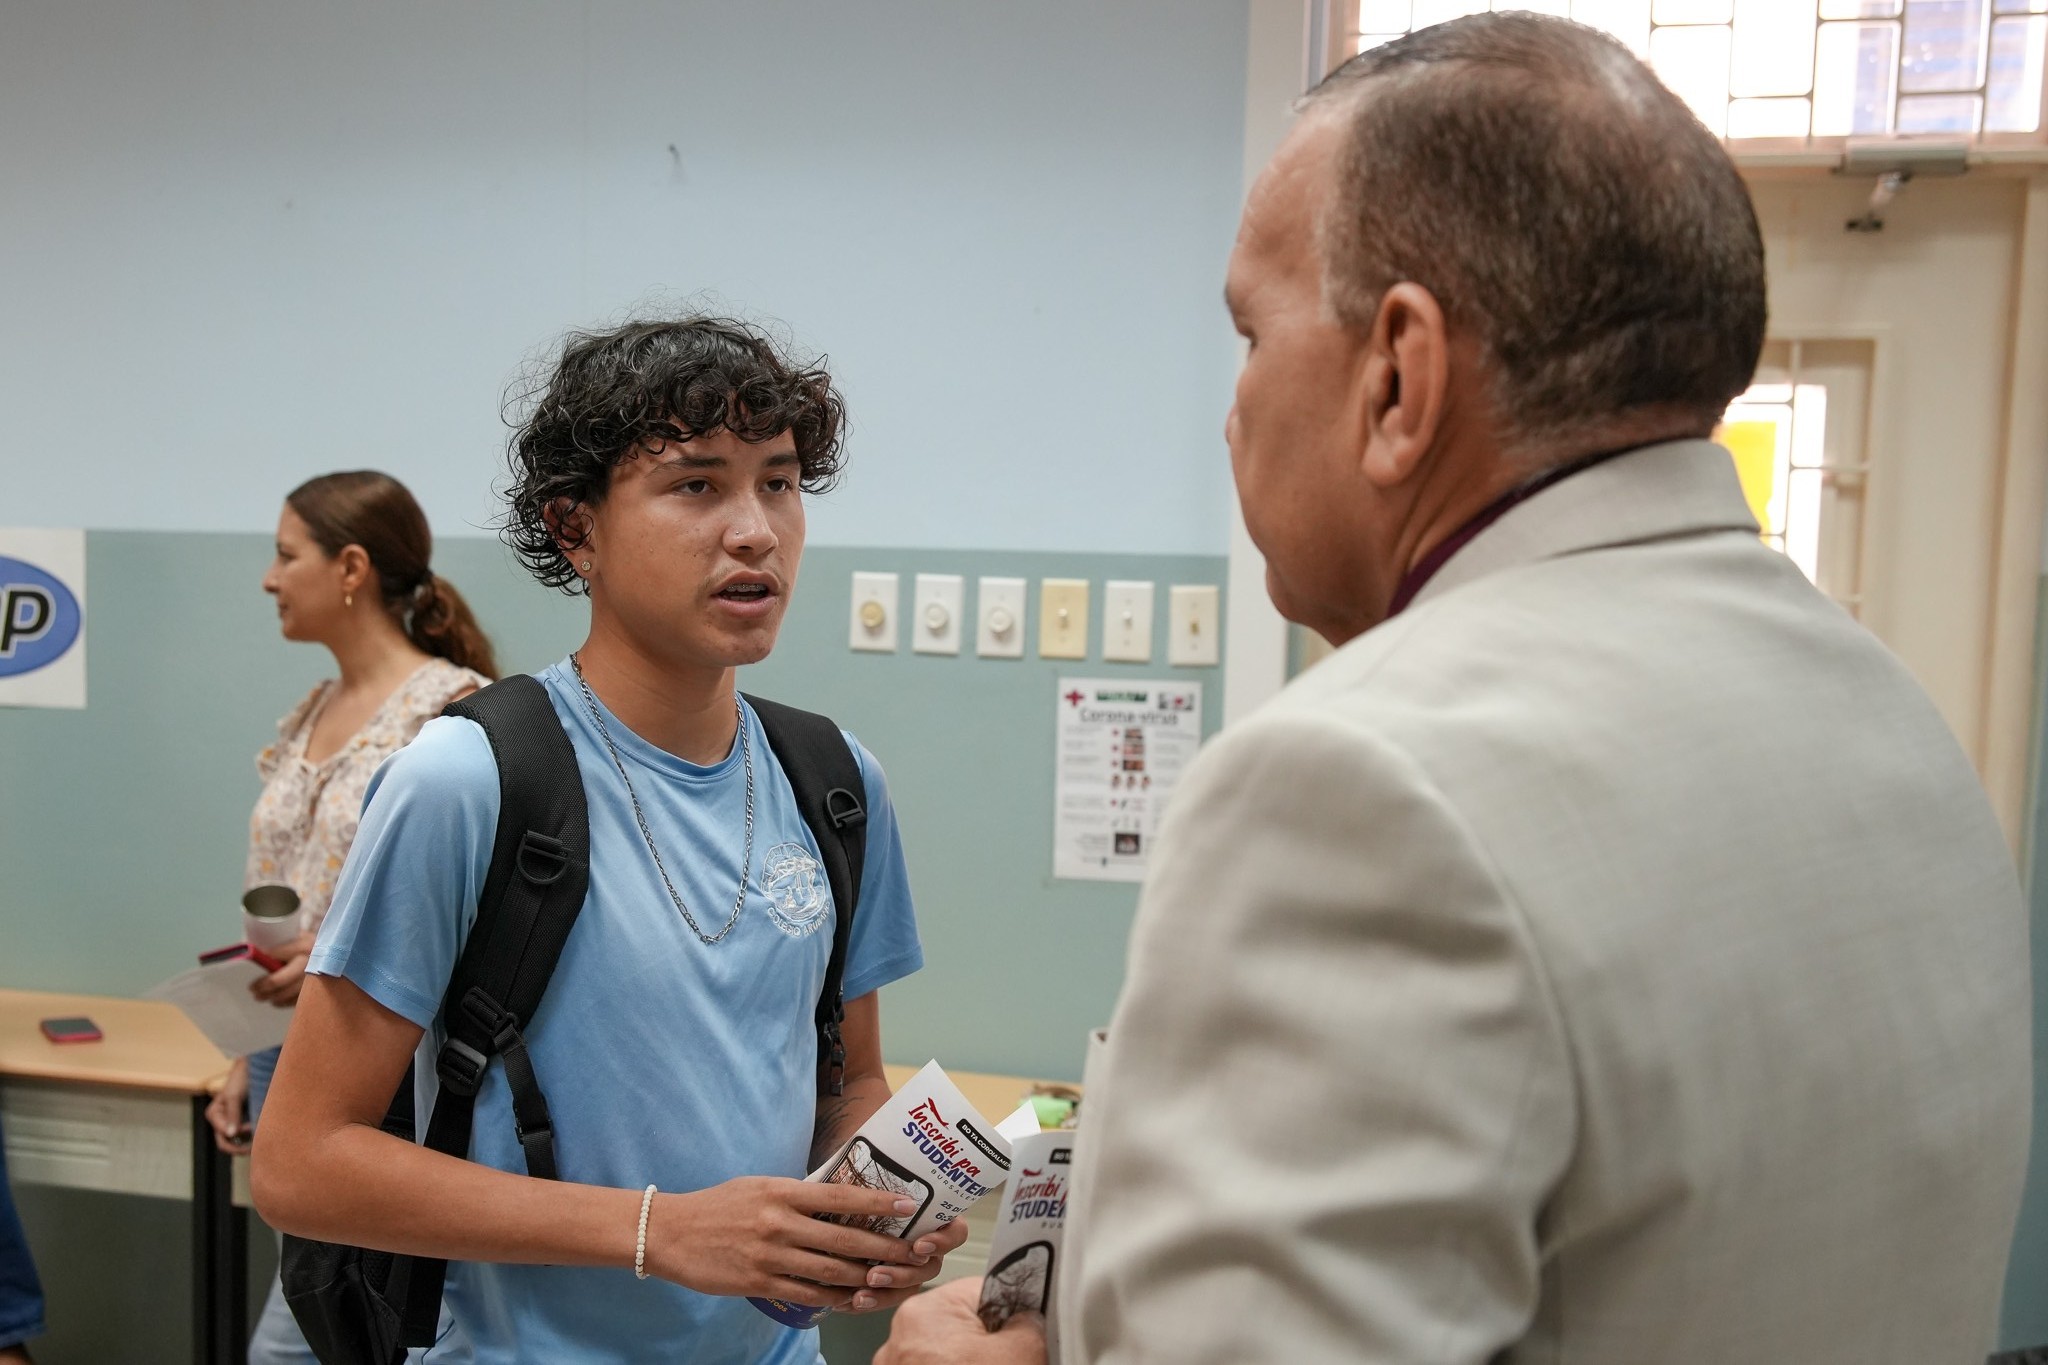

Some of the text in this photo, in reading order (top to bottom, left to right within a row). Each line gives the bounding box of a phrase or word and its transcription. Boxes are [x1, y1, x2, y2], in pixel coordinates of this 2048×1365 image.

[768, 907, 801, 936] COLEGIO
[908, 1102, 981, 1178] Inscribi pa
[961, 1124, 972, 1134] BO
[971, 1133, 979, 1142] TA
[940, 1200, 953, 1213] 25
[935, 1211, 957, 1222] 6:3
